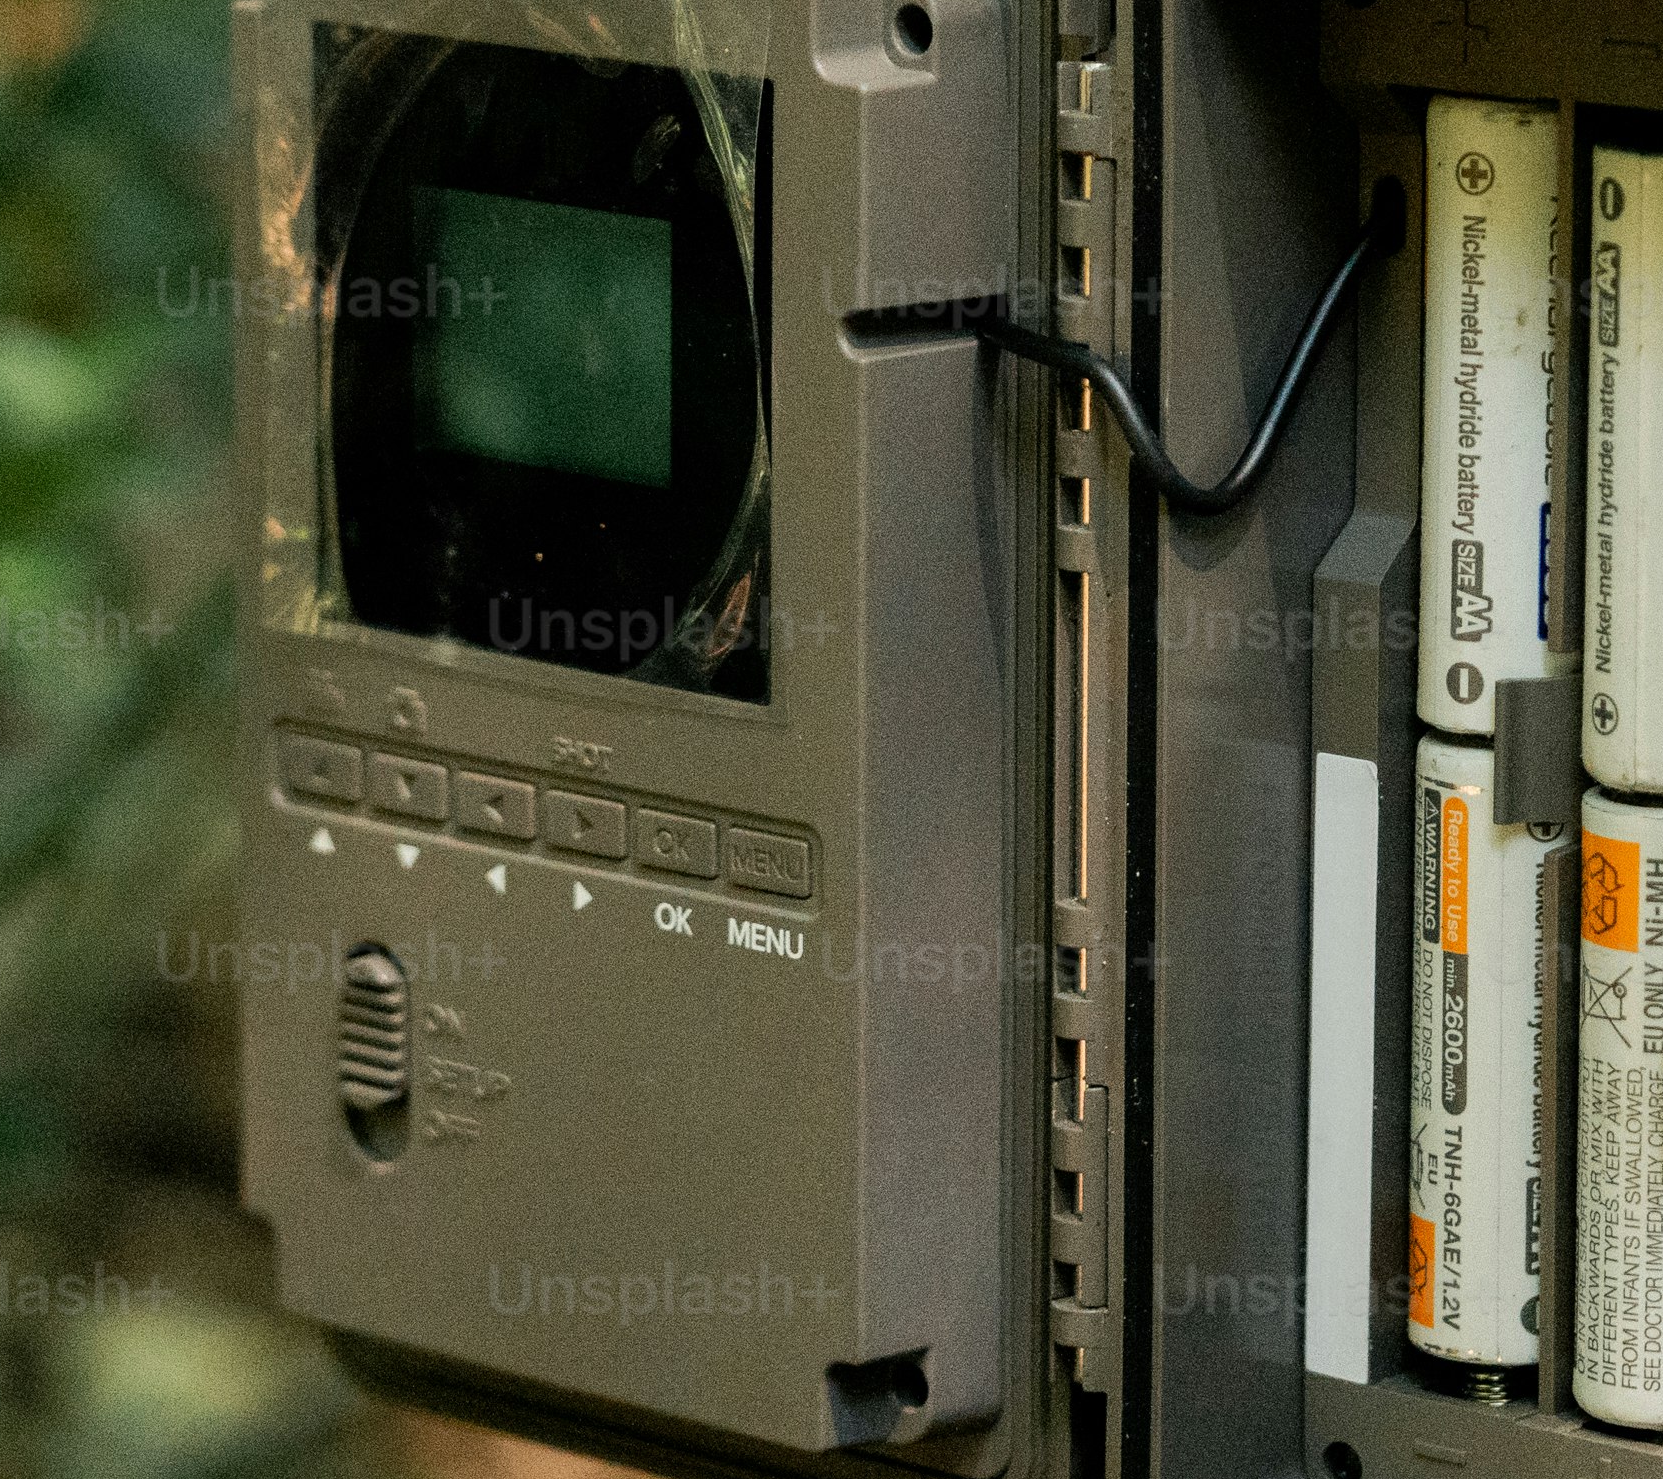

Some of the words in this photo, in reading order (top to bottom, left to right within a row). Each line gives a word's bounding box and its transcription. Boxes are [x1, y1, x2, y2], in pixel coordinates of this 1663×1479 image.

[1461, 215, 1487, 356] Nickel-metal
[1596, 249, 1617, 295] AA
[1600, 299, 1616, 342] SIZE
[1454, 362, 1484, 448] hydride
[1598, 353, 1620, 434] battery
[1452, 453, 1481, 534] battery
[1597, 441, 1618, 527] hydride
[1457, 544, 1477, 586] SIZE
[1456, 589, 1491, 634] AA
[1595, 533, 1612, 674] Nickel-metal
[1445, 809, 1464, 872] Ready
[1424, 822, 1437, 930] WARNING
[1447, 878, 1462, 898] to
[654, 902, 693, 937] OK
[727, 918, 804, 961] MENU
[1446, 904, 1461, 942] Use
[1423, 949, 1433, 978] DO
[1421, 981, 1433, 1023] NOT
[1421, 1026, 1433, 1110] DISPOSE
[1591, 1058, 1604, 1116] WITH
[1606, 1061, 1622, 1126] AWAY
[1590, 1122, 1603, 1164] MIX
[1605, 1130, 1620, 1186] KEEP
[1624, 1065, 1646, 1205] SWALLOWED,
[1428, 1153, 1439, 1186] EU
[1589, 1170, 1602, 1203] OR
[1442, 1125, 1462, 1330] TNH-6GAE/1.2V
[1603, 1194, 1619, 1265] TYPES.
[1623, 1208, 1641, 1230] IF
[1587, 1209, 1601, 1353] BACKWARDS
[1622, 1235, 1641, 1322] INFANTS
[1602, 1270, 1618, 1387] DIFFERENT
[1643, 1276, 1663, 1353] DOCTOR
[1587, 1358, 1599, 1382] IN
[1621, 1328, 1639, 1390] FROM
[1643, 1358, 1662, 1392] SEE
